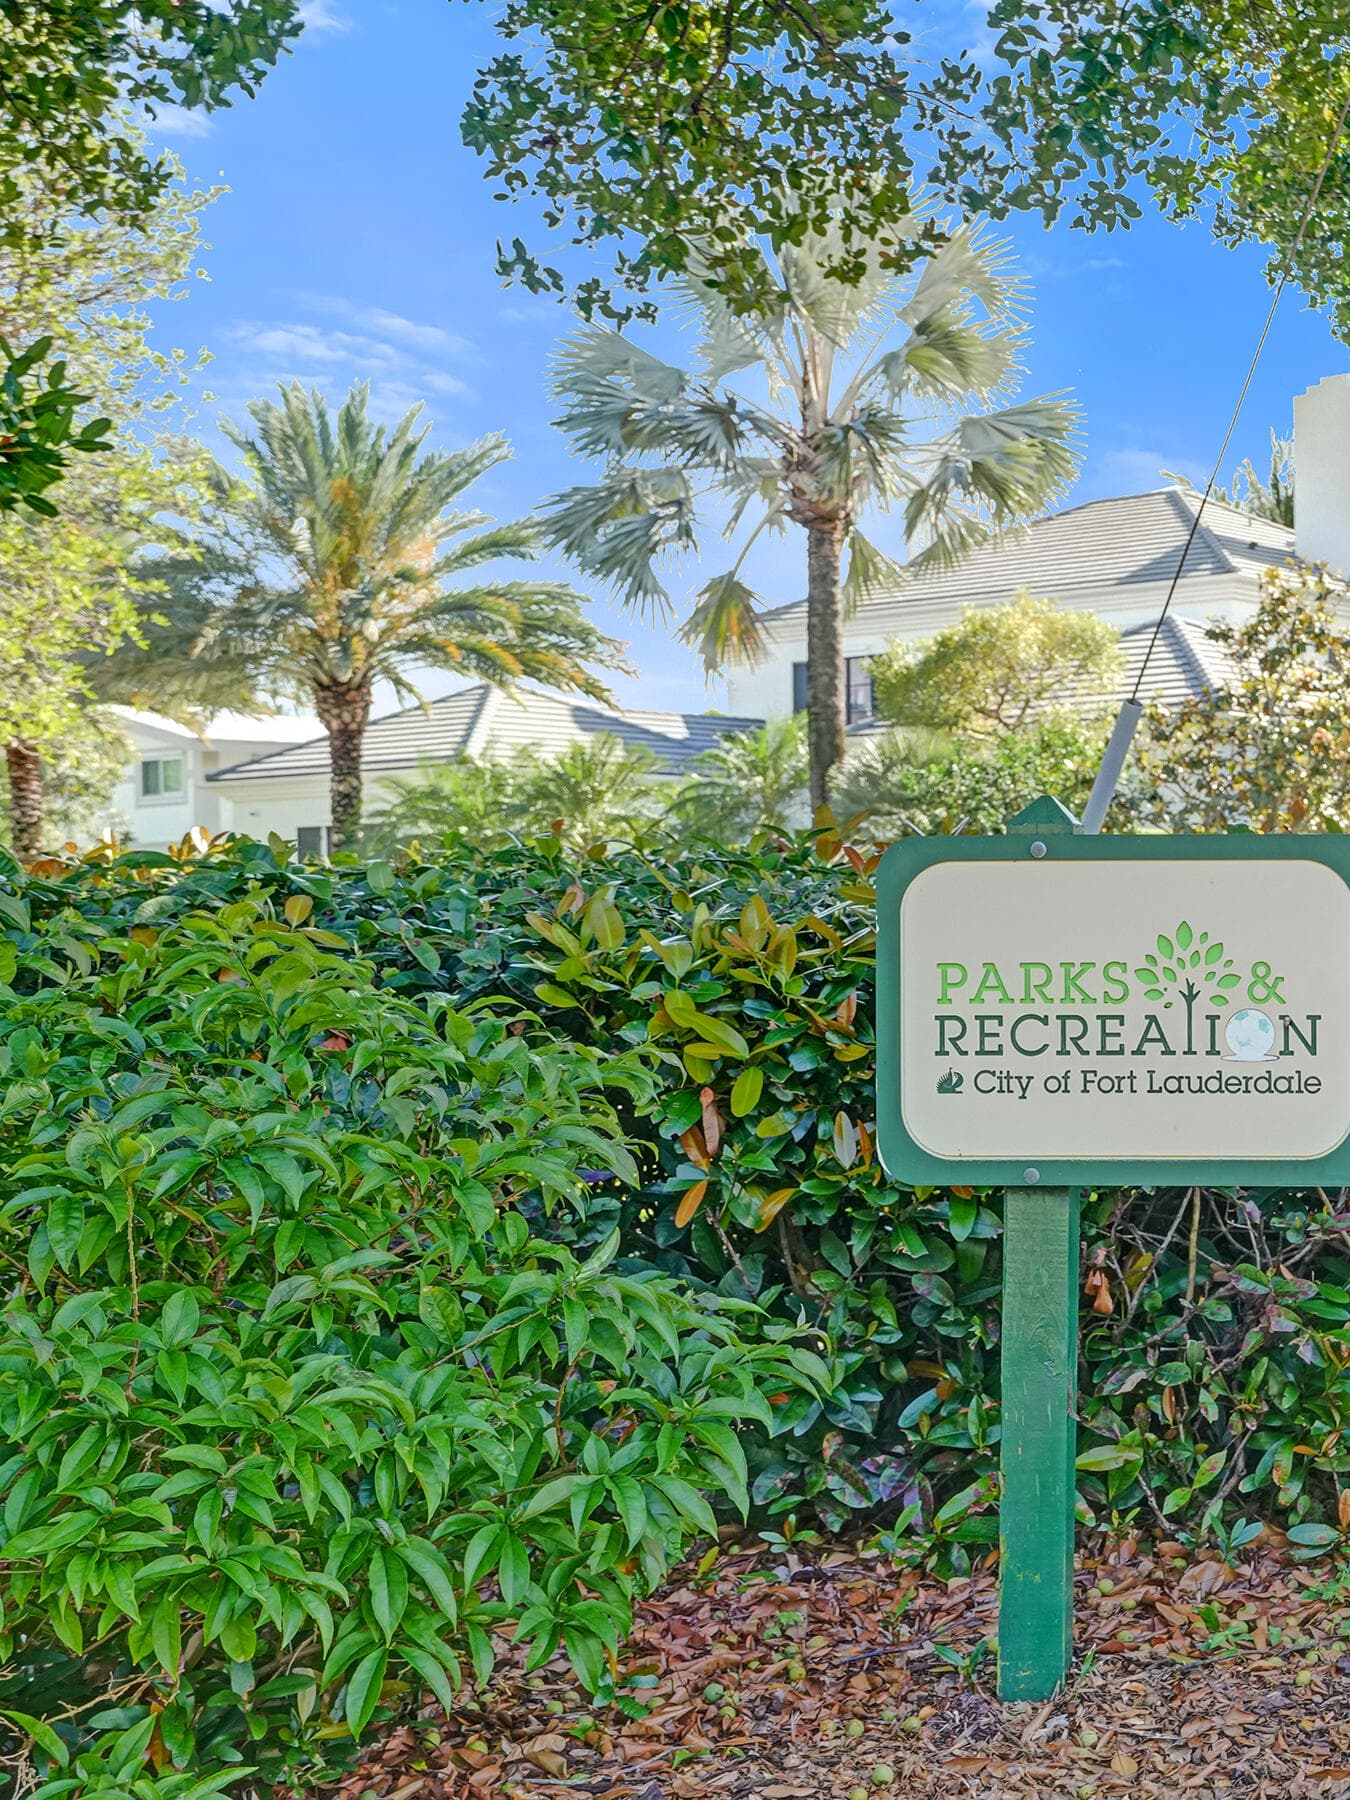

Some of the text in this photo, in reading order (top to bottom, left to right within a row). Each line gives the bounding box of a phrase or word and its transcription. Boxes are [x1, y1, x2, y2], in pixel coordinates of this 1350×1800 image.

[936, 961, 1286, 1004] PARKS &
[973, 1070, 1322, 1099] City of Fort Lauderdale
